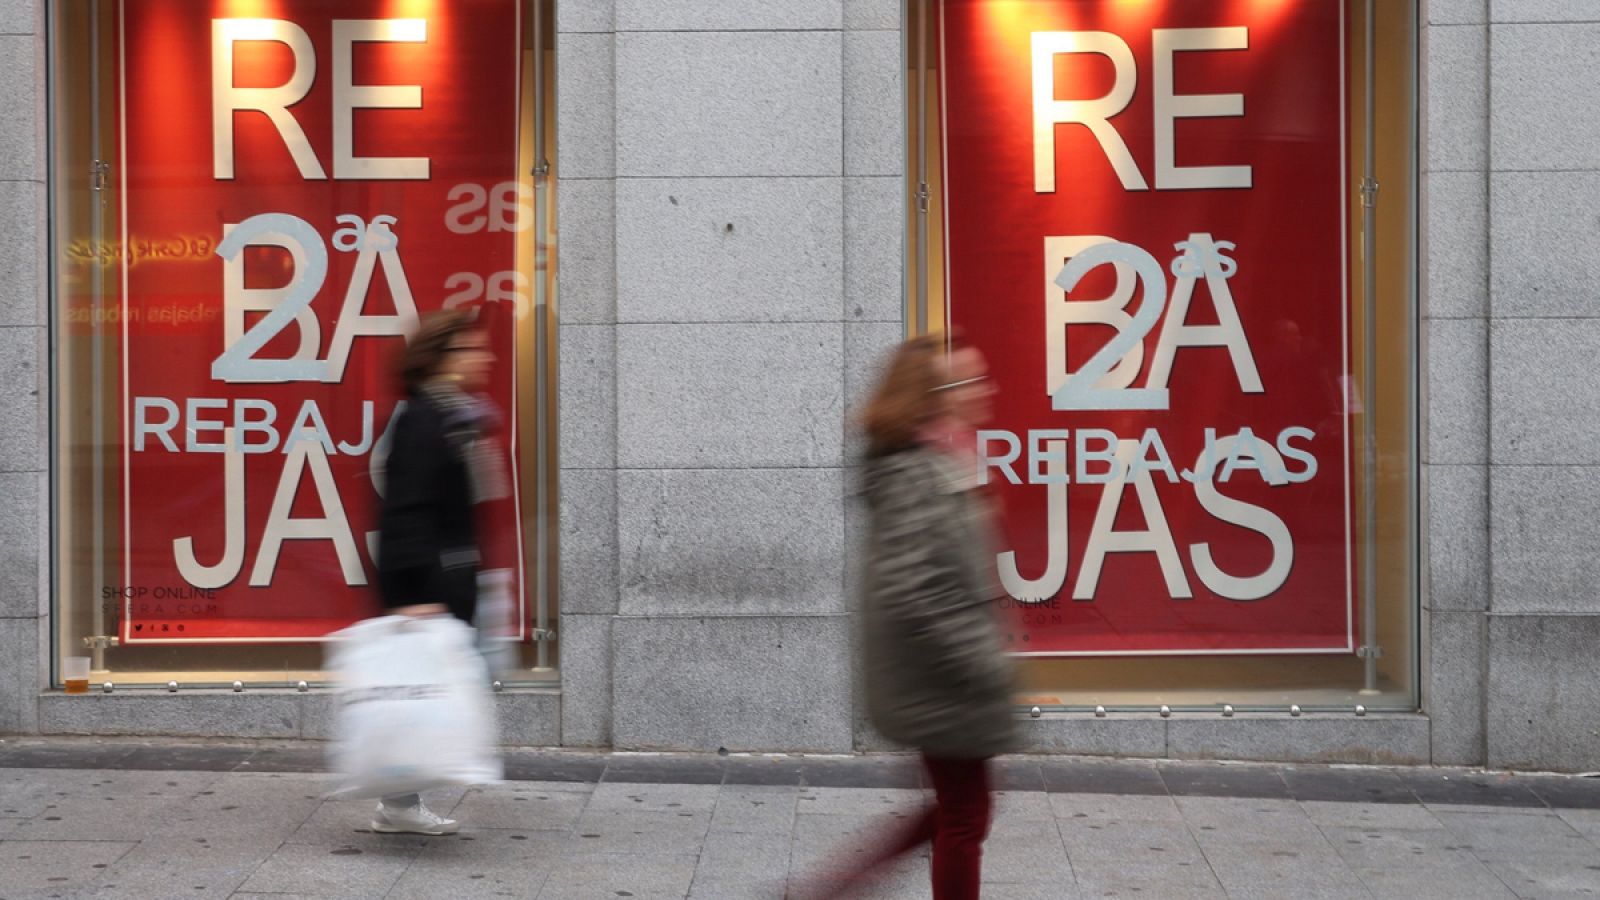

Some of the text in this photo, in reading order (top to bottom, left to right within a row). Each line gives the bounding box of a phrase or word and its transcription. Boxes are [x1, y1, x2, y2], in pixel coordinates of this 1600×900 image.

[211, 18, 430, 180] RE
[1030, 26, 1253, 193] RE
[133, 396, 408, 456] REBAJ
[976, 426, 1318, 485] REBAJAS
[173, 427, 388, 589] JA
[996, 435, 1295, 602] JAS
[102, 586, 217, 600] SHOP ONLINE
